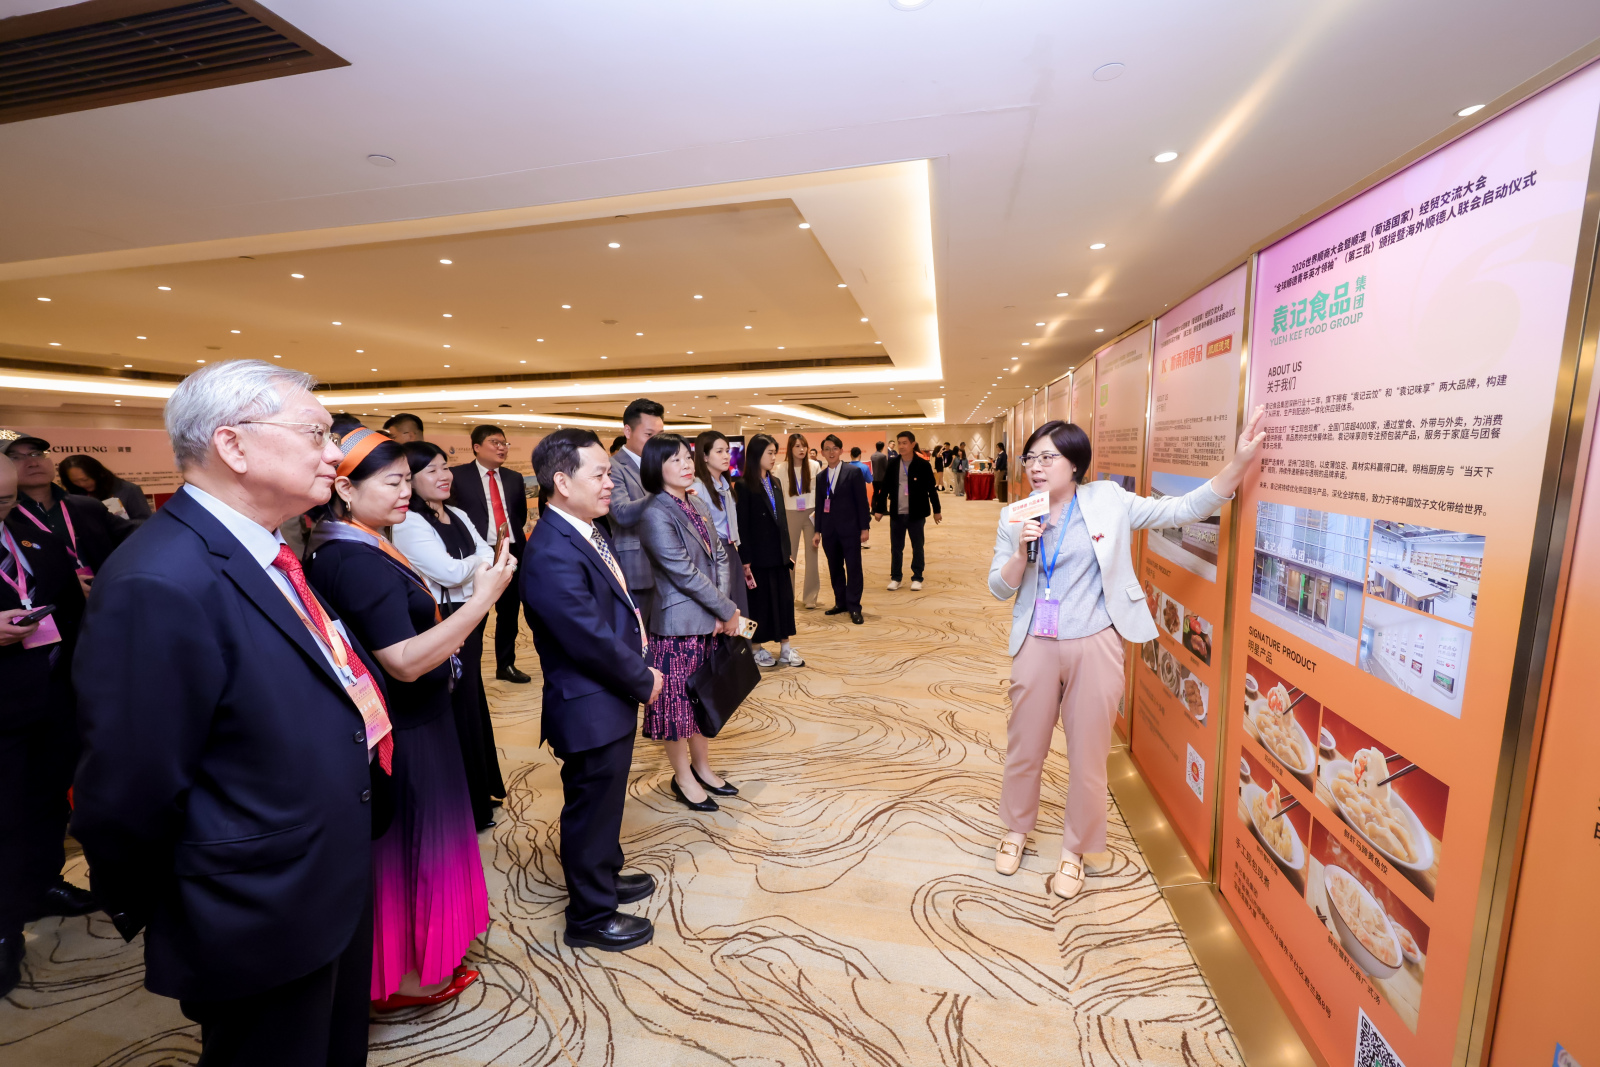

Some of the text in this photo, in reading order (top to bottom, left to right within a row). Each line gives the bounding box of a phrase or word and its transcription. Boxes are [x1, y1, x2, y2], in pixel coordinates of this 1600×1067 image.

[1271, 281, 1352, 335] 袁记食品
[1270, 311, 1363, 346] YUEN KEE FOOD GROUP
[1268, 360, 1301, 377] ABOUT US
[1267, 376, 1296, 393] 关于我们
[1248, 625, 1316, 674] SIGNATURE PRODUCT
[1248, 638, 1272, 665] 明星产品
